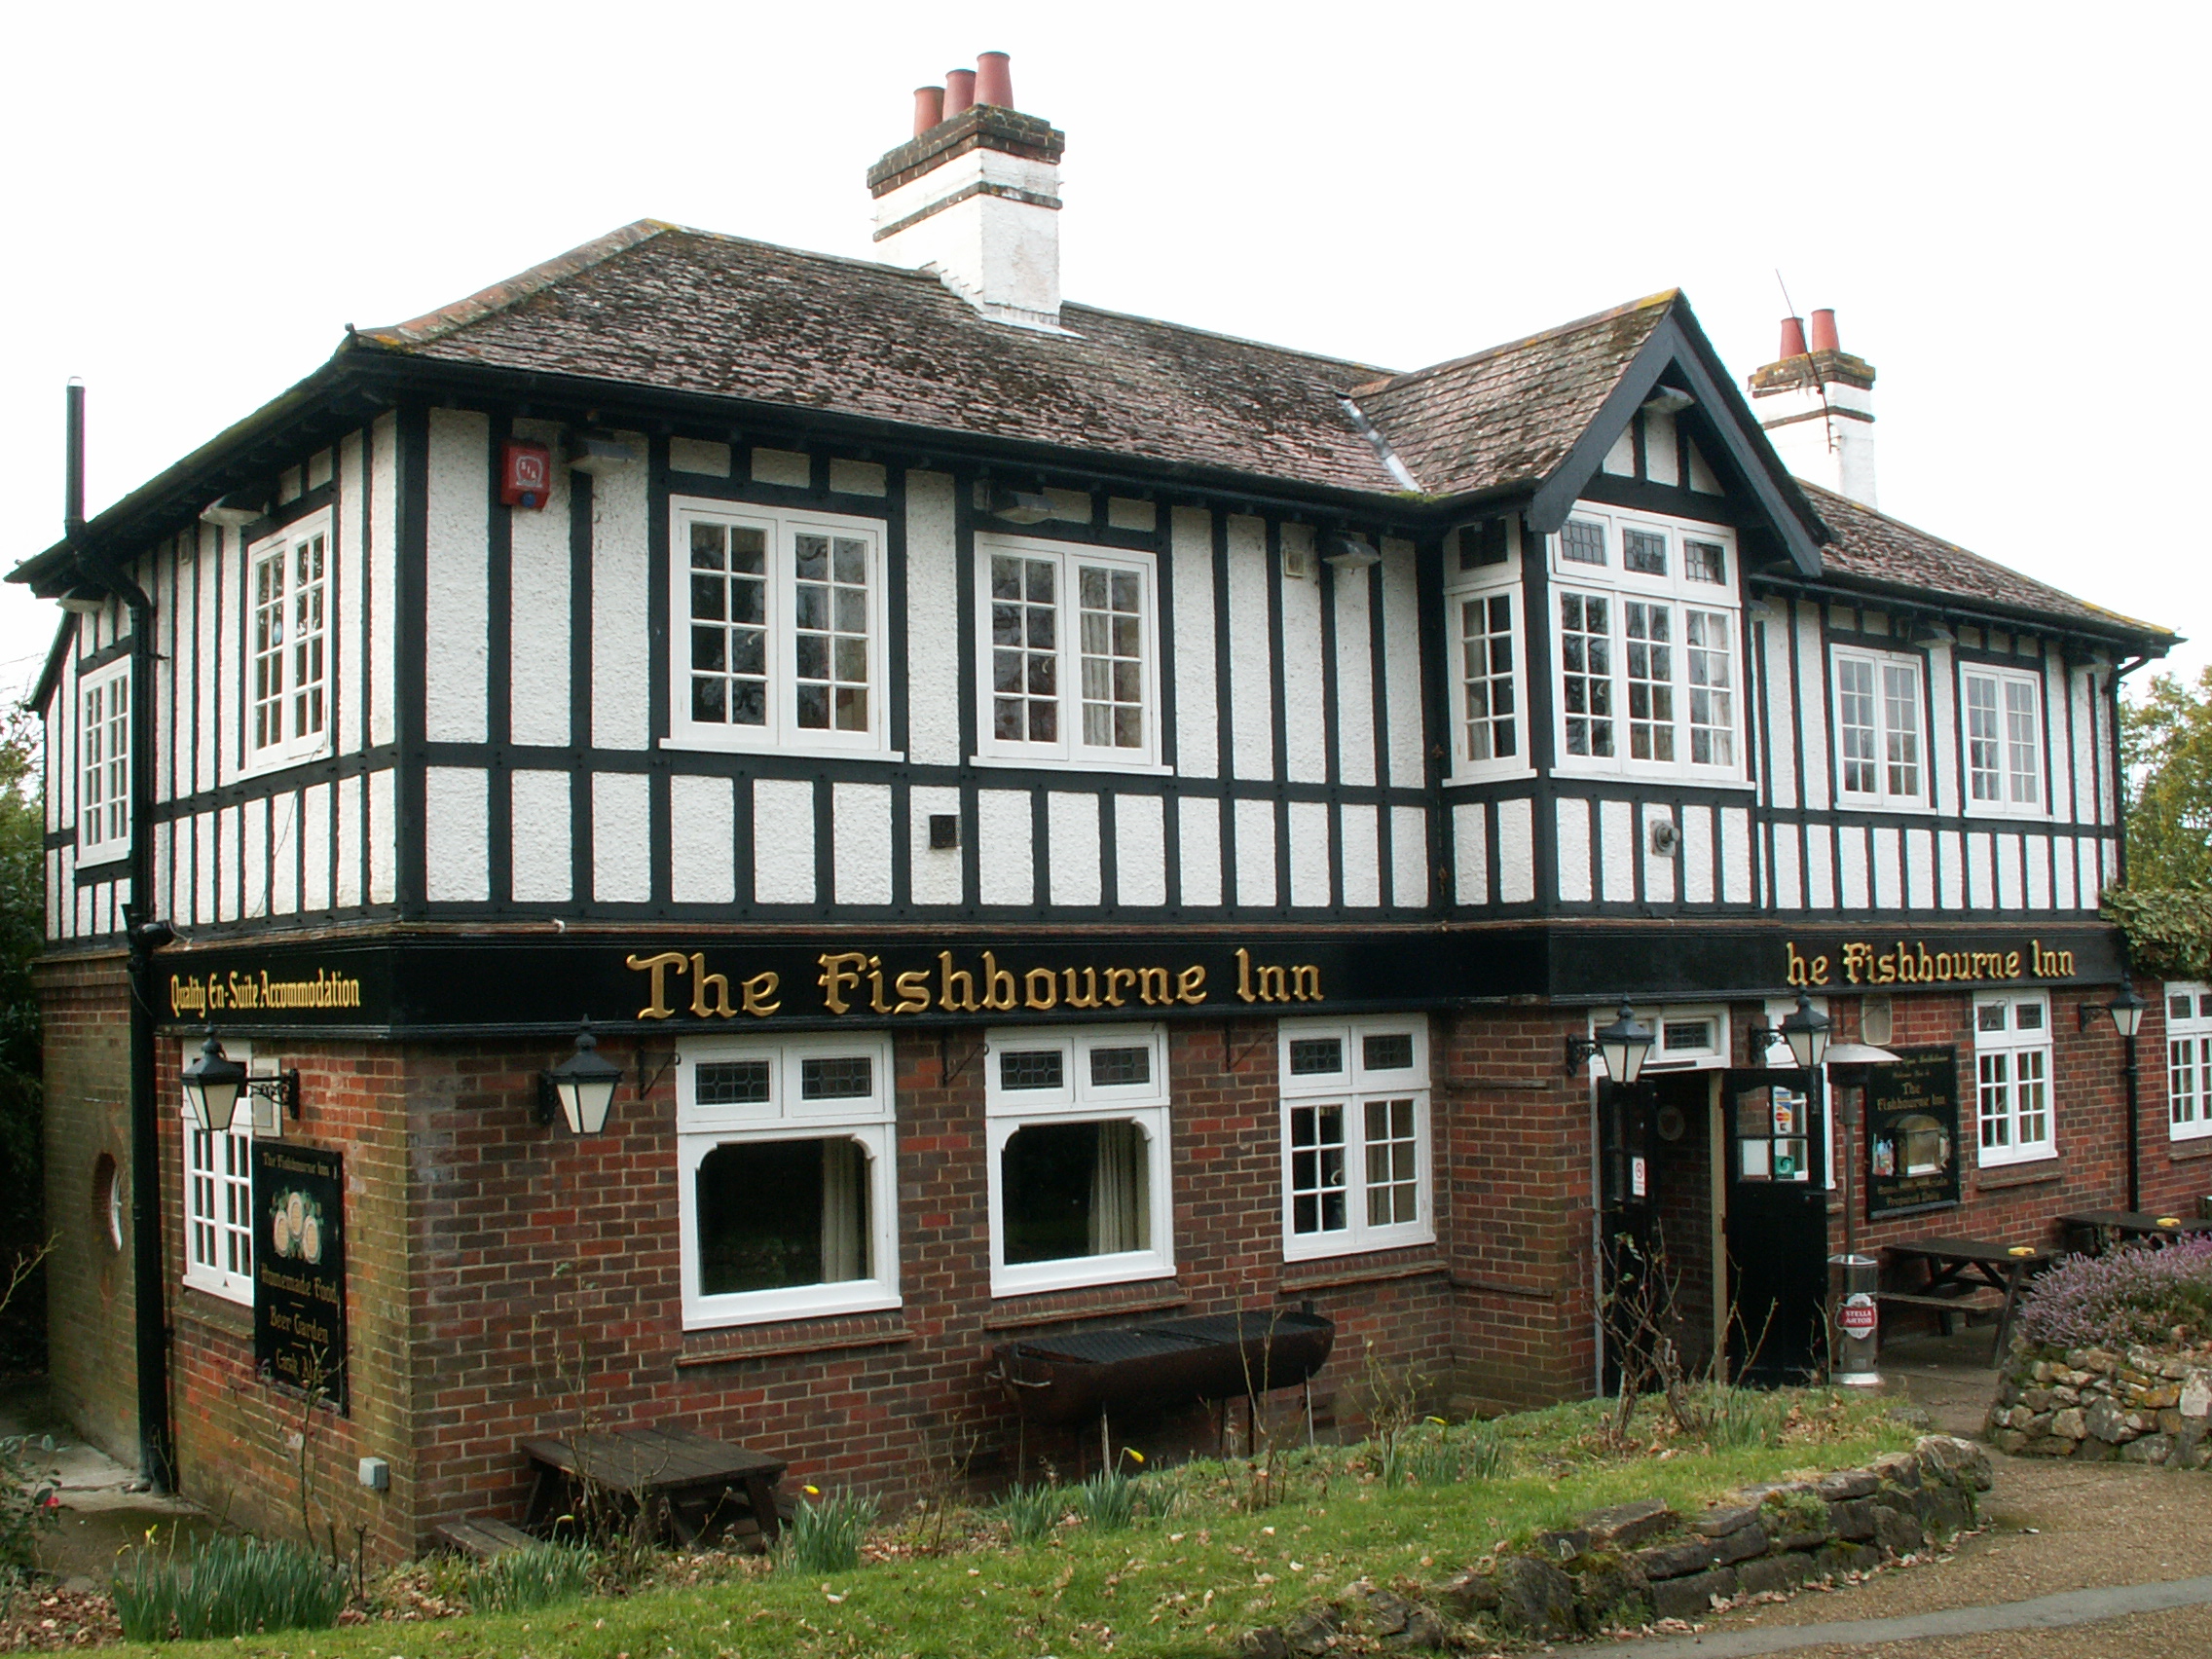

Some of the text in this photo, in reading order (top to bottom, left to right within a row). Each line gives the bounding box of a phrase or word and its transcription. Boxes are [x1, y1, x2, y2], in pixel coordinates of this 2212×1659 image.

[626, 947, 1324, 1019] The Fishbourne Inn
[1786, 939, 2076, 985] he Fishbourne Inn
[170, 967, 361, 1018] Quality En-Suite Accommodation
[1901, 1082, 1923, 1095] The
[262, 1152, 276, 1167] The
[261, 1262, 339, 1304] Homemade Food
[269, 1305, 329, 1345] Beer Garden
